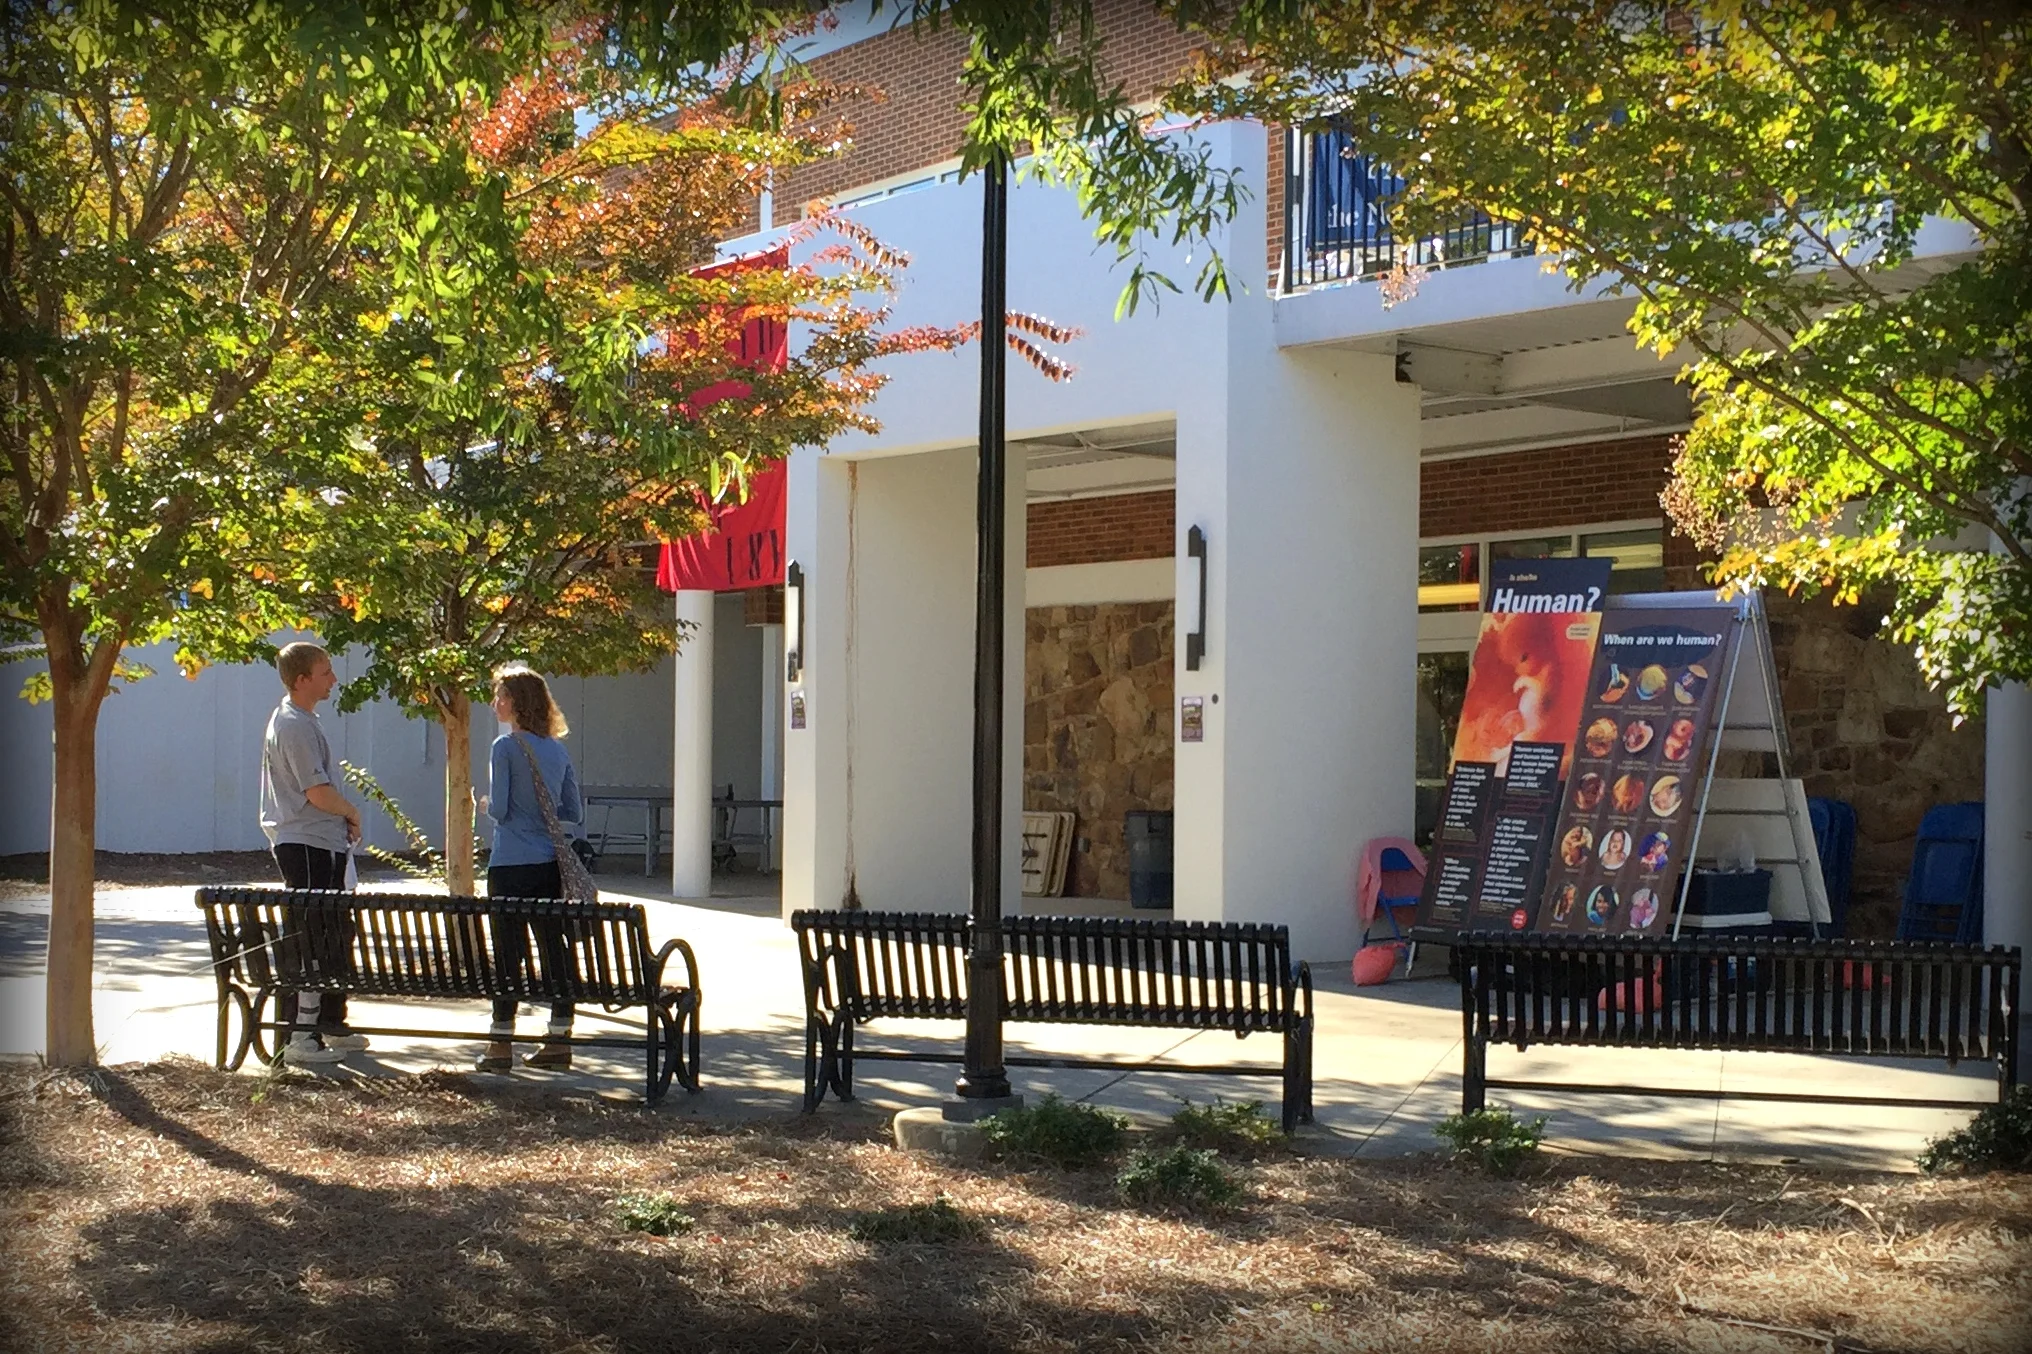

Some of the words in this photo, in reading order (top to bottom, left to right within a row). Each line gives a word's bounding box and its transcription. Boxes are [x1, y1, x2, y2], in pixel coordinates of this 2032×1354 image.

[1492, 586, 1601, 614] Human?
[1603, 633, 1634, 646] When
[1636, 636, 1655, 646] are
[1657, 636, 1674, 646] we
[1676, 633, 1722, 646] human?
